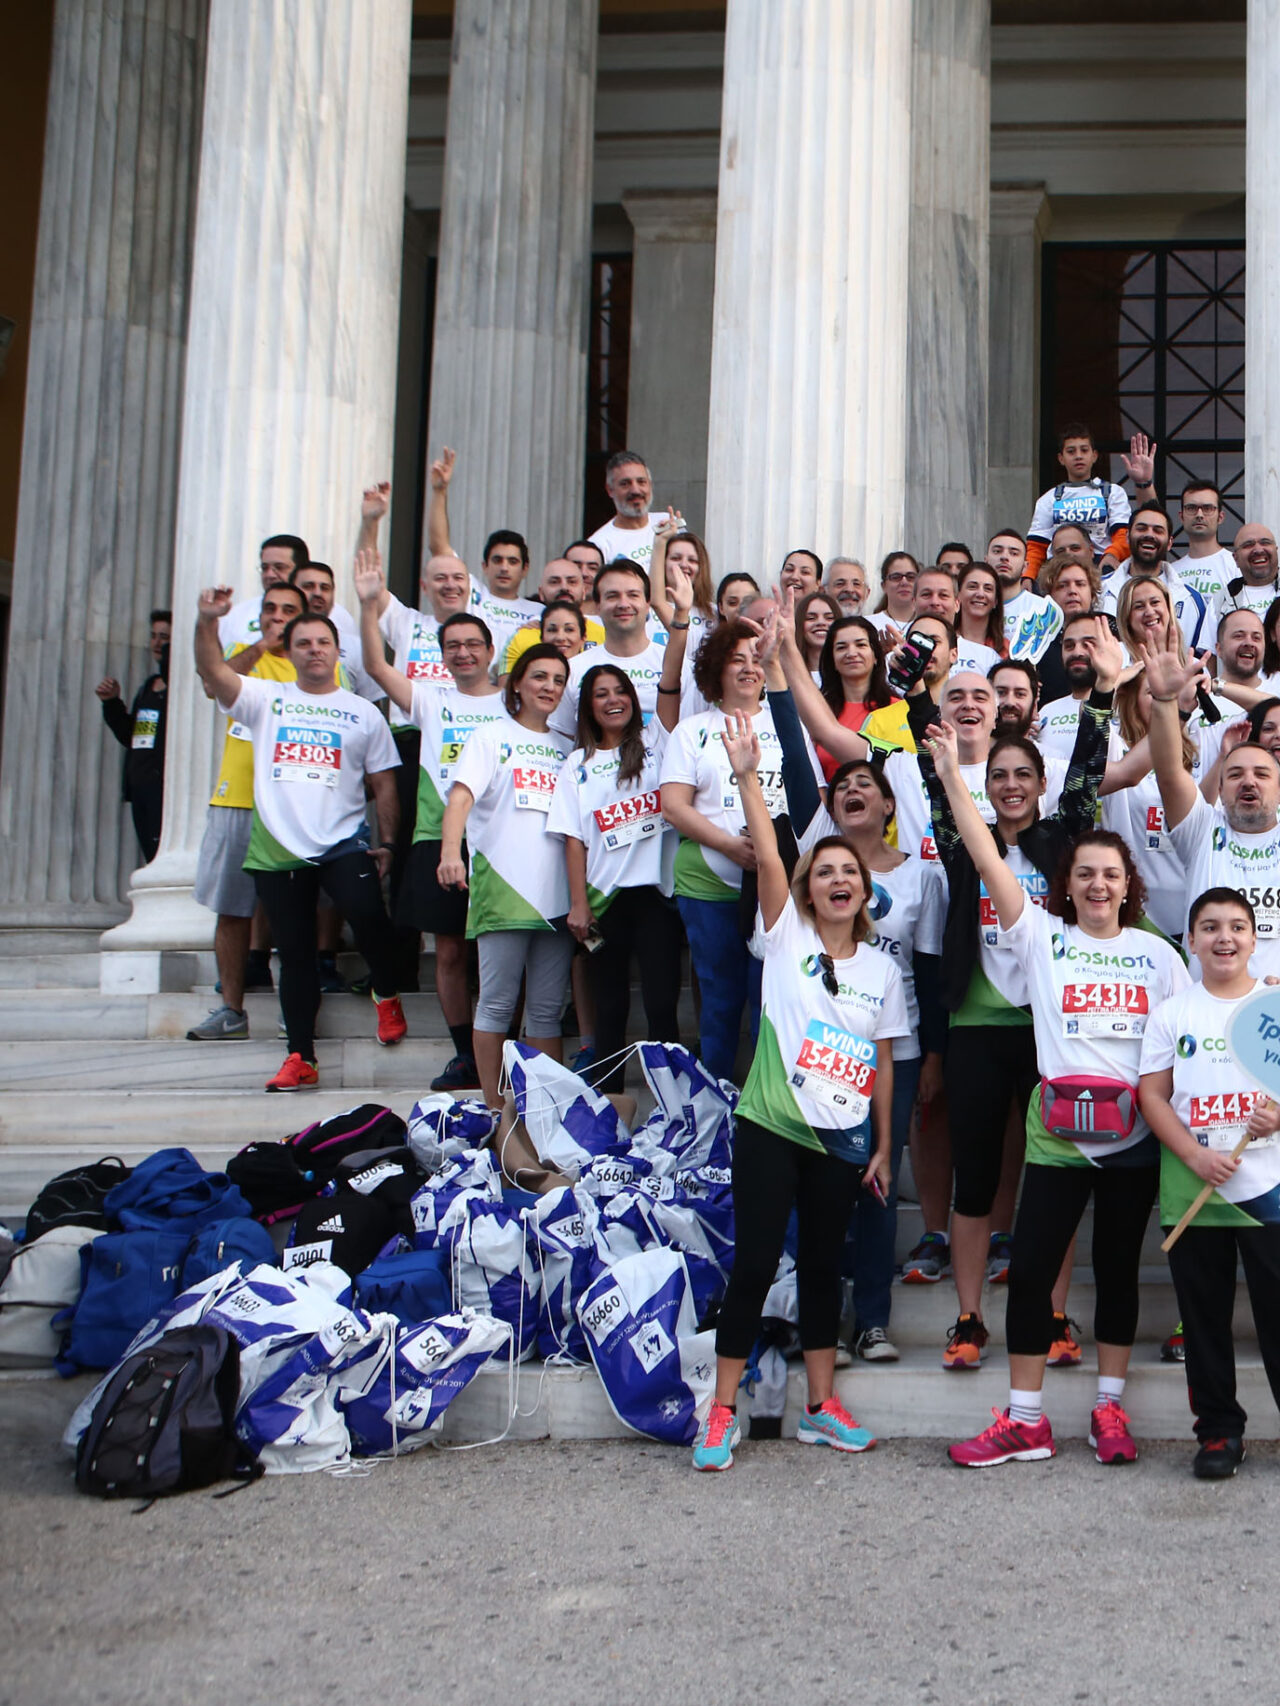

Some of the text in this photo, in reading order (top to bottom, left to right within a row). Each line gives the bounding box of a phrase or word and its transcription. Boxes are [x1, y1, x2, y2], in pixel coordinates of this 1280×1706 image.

[1063, 497, 1098, 508] WIND
[1059, 508, 1100, 522] 56574
[285, 703, 360, 724] COSMOTE
[286, 729, 333, 744] WIND
[279, 743, 336, 764] 54305
[728, 770, 784, 789] 6573
[601, 791, 657, 827] 54329
[1073, 983, 1140, 1008] 54312
[822, 1026, 875, 1061] WIND
[807, 1043, 871, 1088] 54358
[317, 1225, 345, 1234] adidas
[587, 1295, 620, 1331] 56660
